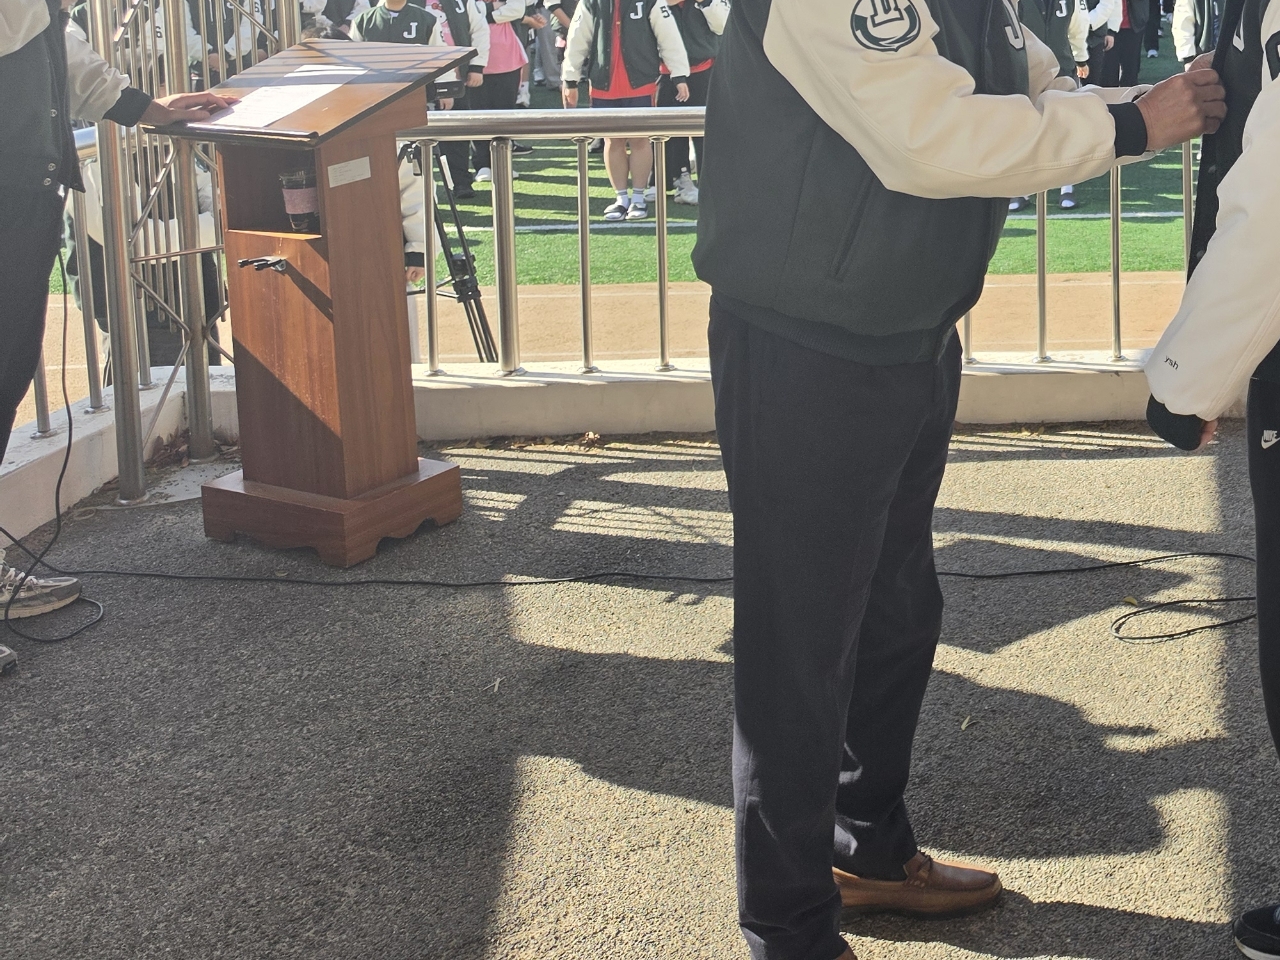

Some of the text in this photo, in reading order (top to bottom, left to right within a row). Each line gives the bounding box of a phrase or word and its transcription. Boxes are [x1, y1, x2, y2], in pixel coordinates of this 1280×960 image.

[629, 1, 644, 20] J
[1055, 0, 1068, 18] J
[402, 21, 418, 39] J
[1163, 355, 1179, 371] ysh
